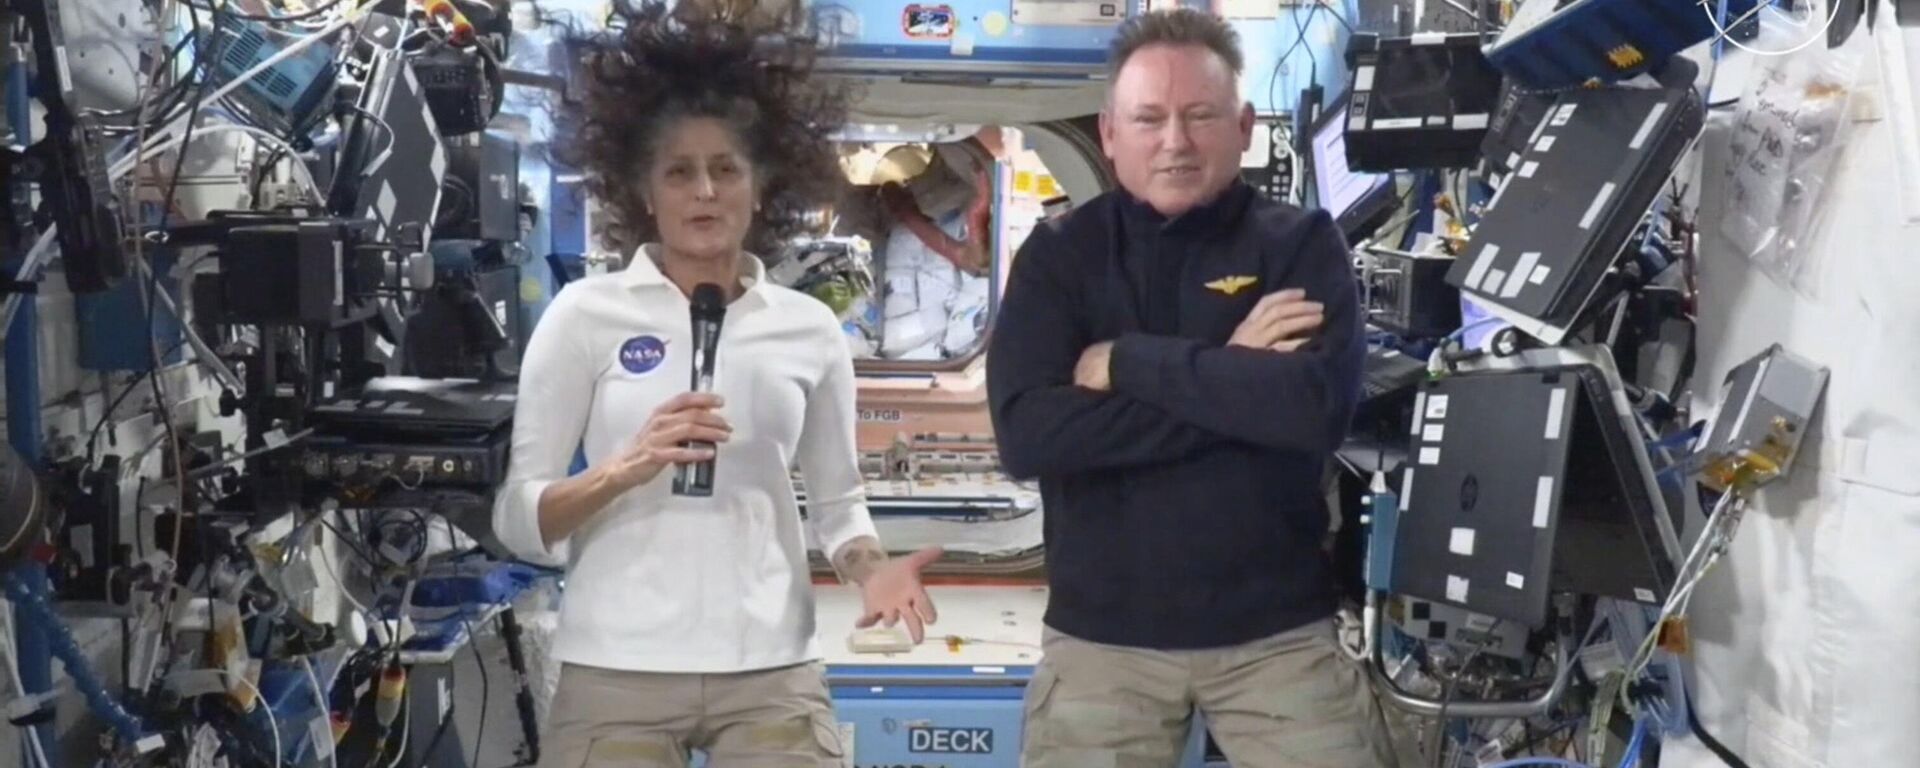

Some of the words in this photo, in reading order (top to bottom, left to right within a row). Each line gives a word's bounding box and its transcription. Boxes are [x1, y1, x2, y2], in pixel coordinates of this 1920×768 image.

[623, 348, 662, 360] NASA
[857, 409, 871, 420] To
[874, 409, 901, 420] FGB
[912, 729, 990, 752] DECK
